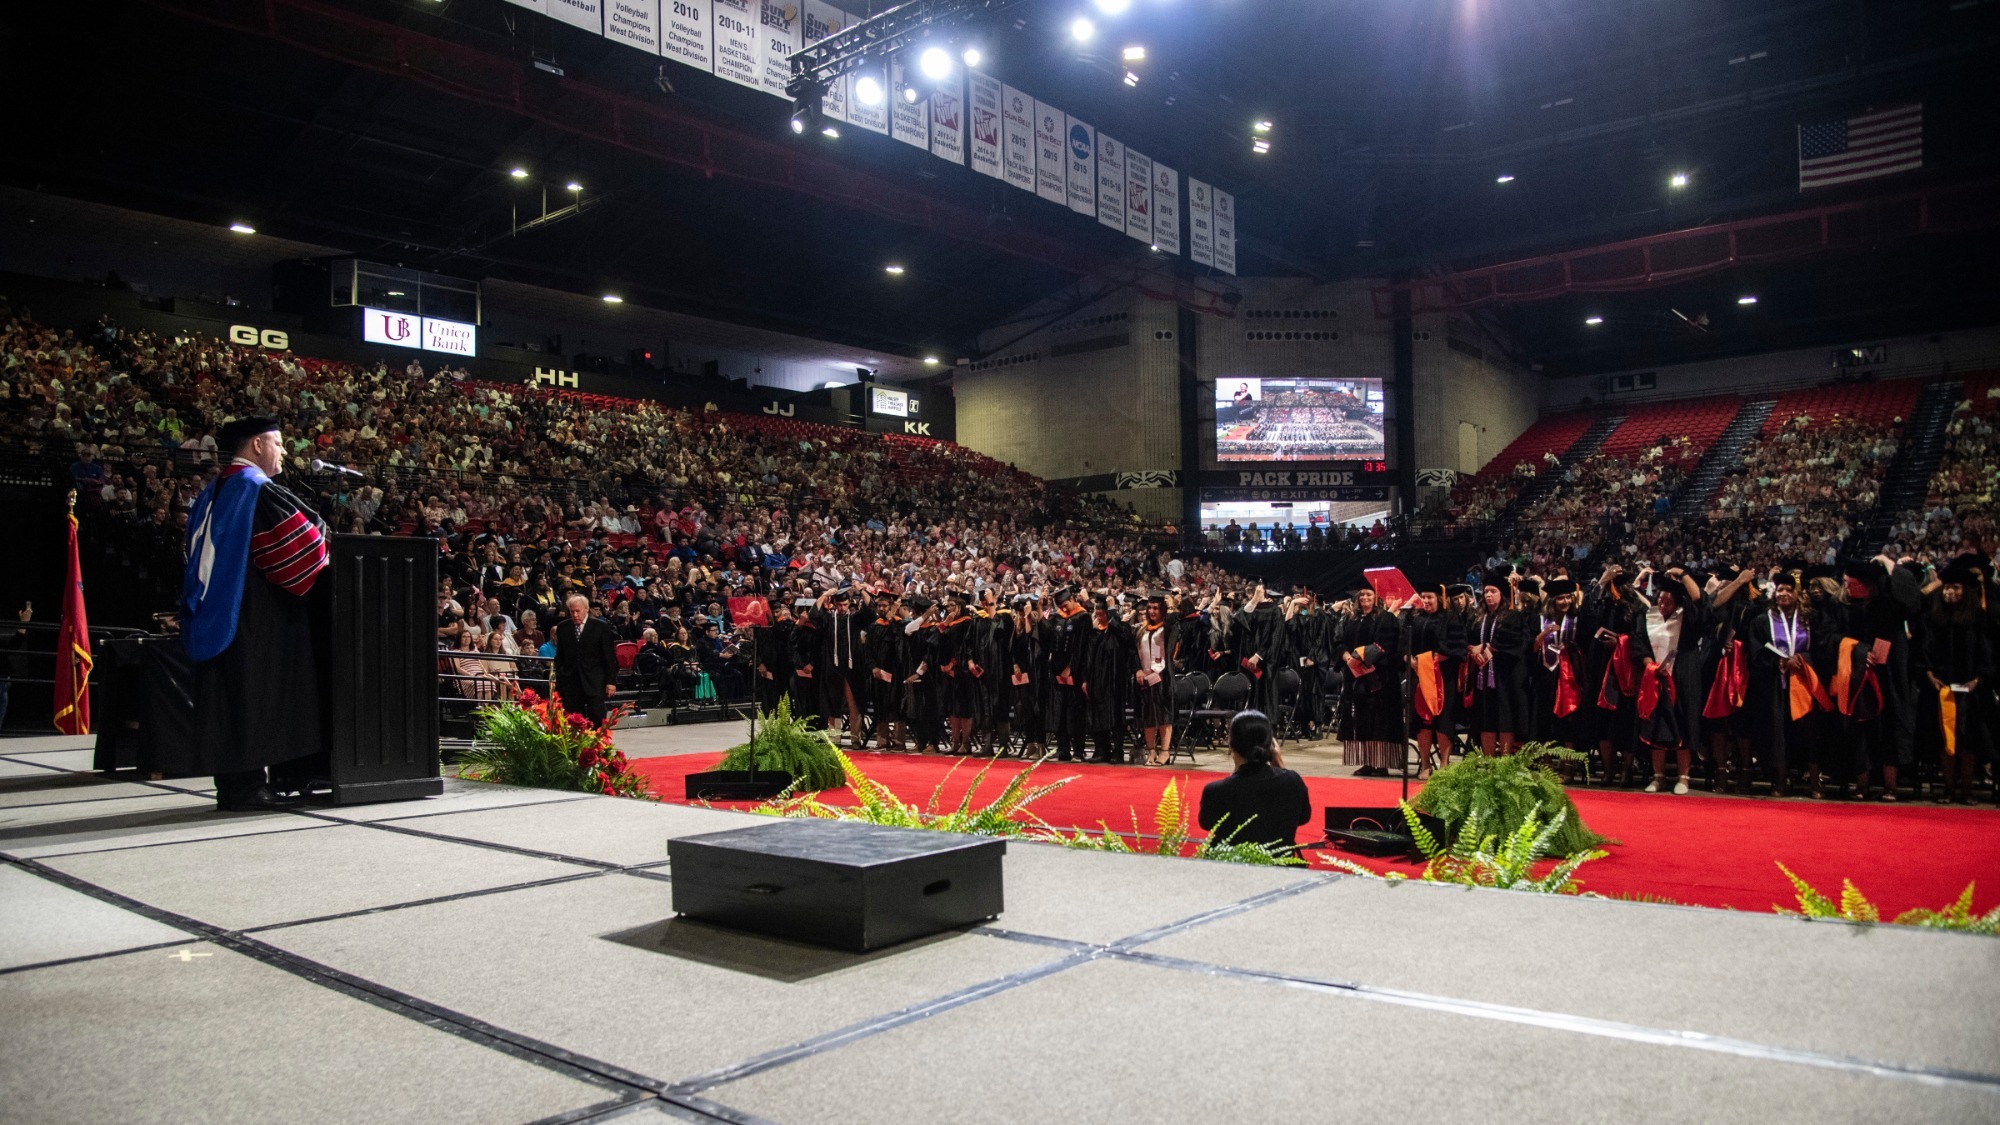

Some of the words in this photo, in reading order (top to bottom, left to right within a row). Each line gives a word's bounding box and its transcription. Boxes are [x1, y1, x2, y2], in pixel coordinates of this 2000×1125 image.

[615, 1, 649, 20] Volleyball
[673, 1, 699, 21] 2010
[612, 12, 651, 33] Champions
[671, 20, 702, 38] Volleyball
[718, 14, 755, 39] 2010-11
[760, 11, 791, 30] BELT
[806, 13, 830, 31] SUN
[609, 23, 627, 37] West
[628, 27, 655, 46] Division
[668, 31, 704, 51] Champions
[665, 41, 681, 54] West
[682, 47, 708, 64] Division
[729, 38, 748, 51] MEN'S
[770, 38, 792, 55] 2011
[719, 45, 757, 65] BASKETBALL
[721, 56, 753, 74] CHAMPION
[717, 65, 734, 77] WEST
[734, 72, 760, 86] DIVISION
[763, 76, 778, 89] West
[1011, 133, 1027, 149] 2015
[1043, 148, 1058, 163] 2015
[1073, 161, 1088, 175] 2015
[229, 324, 289, 350] GG
[428, 321, 471, 340] Unico
[431, 335, 468, 353] Bank
[535, 366, 579, 389] HH
[762, 400, 796, 418] JJ
[904, 420, 931, 437] KK
[1239, 472, 1291, 486] PACK
[1296, 471, 1354, 486] PRIDE
[1280, 490, 1309, 500] EXIT
